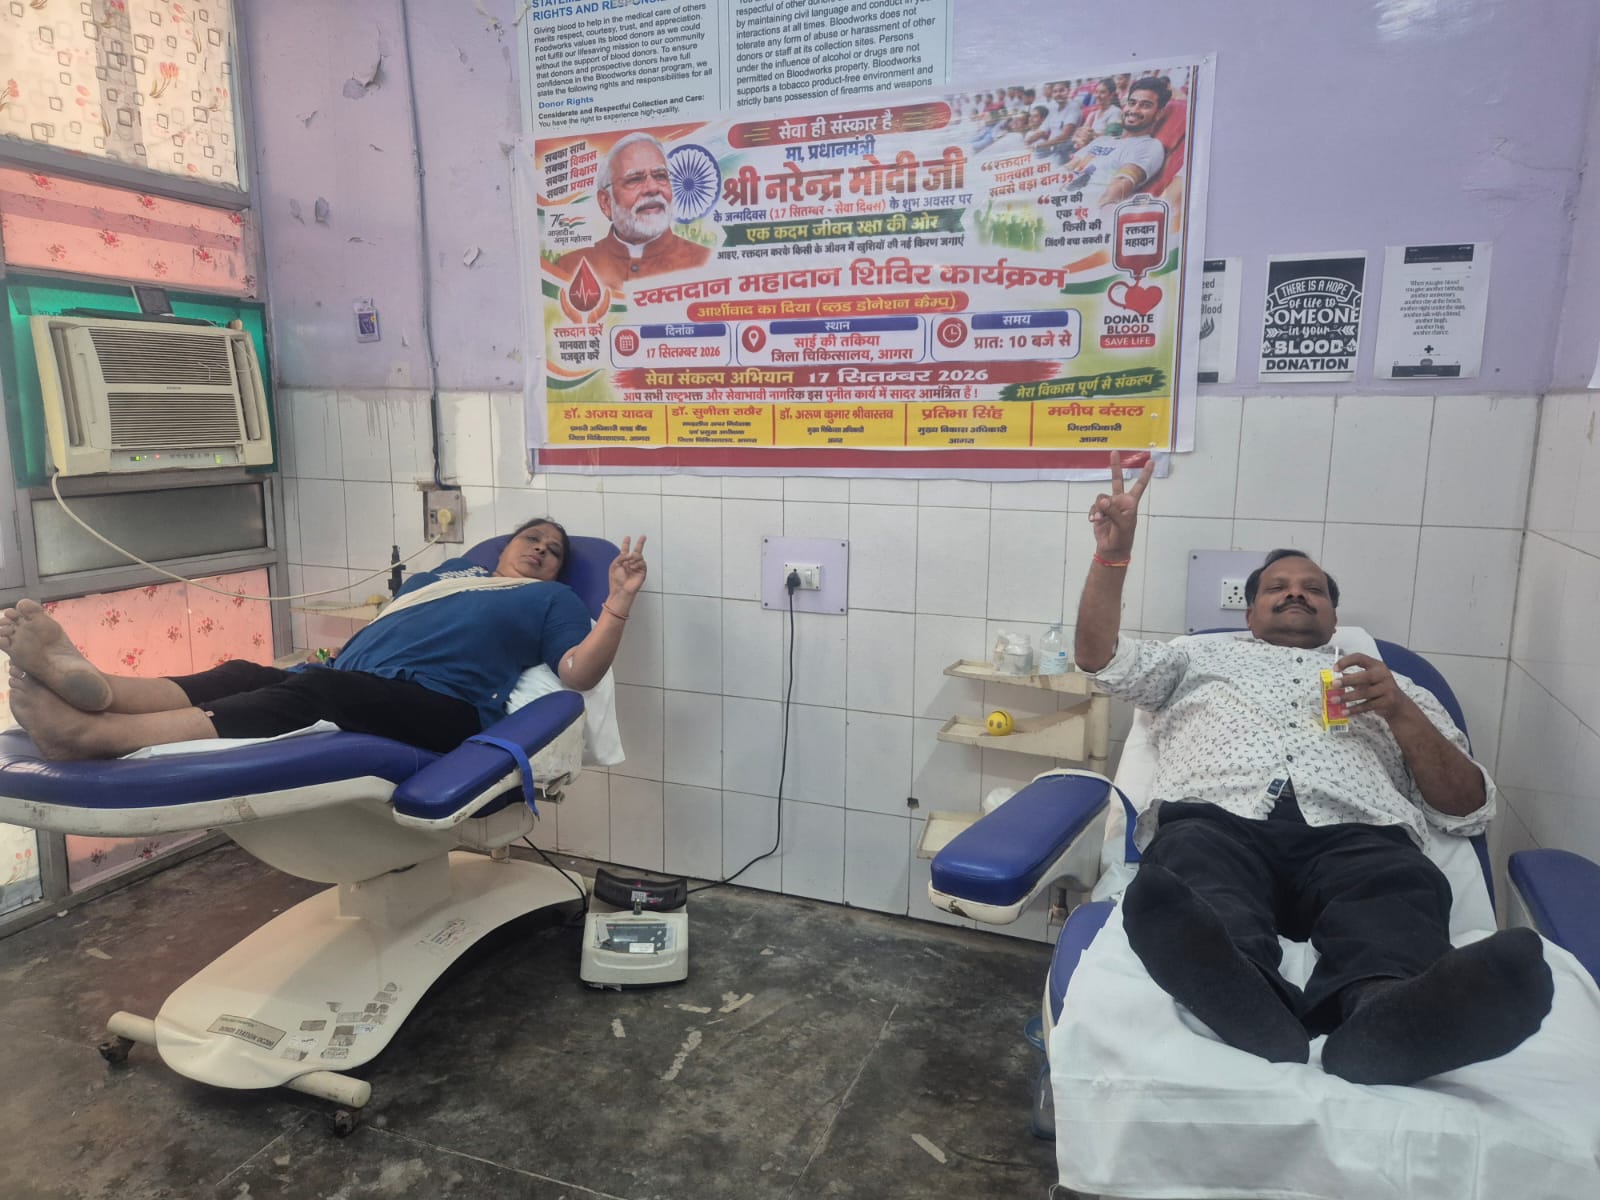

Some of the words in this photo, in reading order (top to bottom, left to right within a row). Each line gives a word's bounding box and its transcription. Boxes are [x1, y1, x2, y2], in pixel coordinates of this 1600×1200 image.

[533, 7, 572, 21] RIGHTS
[576, 3, 598, 14] AND
[737, 85, 769, 95] supports
[779, 81, 809, 90] tobacco
[812, 74, 860, 88] product-free
[863, 68, 914, 80] environment
[917, 64, 933, 74] and
[737, 96, 761, 107] strictly
[764, 95, 782, 104] bans
[784, 89, 828, 102] possession
[831, 87, 838, 96] of
[840, 85, 873, 94] firearms
[876, 82, 891, 91] and
[894, 78, 932, 88] weapons
[538, 110, 578, 119] Considerate
[594, 103, 630, 113] Respectful
[632, 98, 668, 108] Collection
[566, 97, 594, 106] Rights
[778, 120, 807, 140] सेवा
[811, 116, 827, 138] ही
[830, 115, 878, 134] संस्कार
[808, 134, 875, 160] प्रधानमंत्री
[722, 166, 761, 206] श्री
[848, 151, 920, 195] मोदी
[922, 146, 967, 190] जी
[746, 227, 770, 242] एक
[773, 225, 808, 240] कदम
[813, 218, 853, 237] जीवन
[886, 214, 907, 231] की
[912, 212, 939, 230] ओर
[633, 278, 732, 308] रक्तदान
[738, 267, 842, 293] महादान
[849, 256, 933, 285] शिविर
[939, 258, 1067, 289] कार्यक्रम
[1281, 281, 1306, 296] THERE
[1308, 280, 1316, 291] IS
[1318, 280, 1325, 290] A
[1326, 280, 1348, 295] HOPE
[758, 302, 776, 314] का
[1289, 299, 1301, 308] of
[1303, 298, 1322, 308] life
[1325, 297, 1336, 307] to
[1002, 315, 1032, 325] समय
[1104, 314, 1154, 325] DONATE
[1265, 308, 1359, 325] SOMEONE
[825, 321, 850, 330] स्थान
[1107, 324, 1149, 334] BLOOD
[1288, 325, 1299, 335] in
[1302, 326, 1330, 338] your
[820, 333, 837, 347] की
[841, 333, 880, 346] तकिया
[1009, 336, 1027, 348] 10
[1031, 330, 1055, 347] बजे
[1059, 330, 1072, 346] से
[1105, 336, 1129, 346] SAVE
[1132, 334, 1150, 345] LIFE
[647, 348, 655, 358] 17
[700, 346, 721, 357] 2026
[1274, 340, 1343, 354] BLOOD
[771, 349, 799, 362] जिला
[878, 348, 913, 359] आगरा
[1266, 358, 1349, 370] DONATION
[645, 370, 672, 385] सेवा
[677, 369, 726, 385] संकल्प
[730, 368, 794, 384] अभियान
[808, 372, 830, 383] 17
[938, 369, 989, 381] 2026
[1038, 382, 1074, 396] विकास
